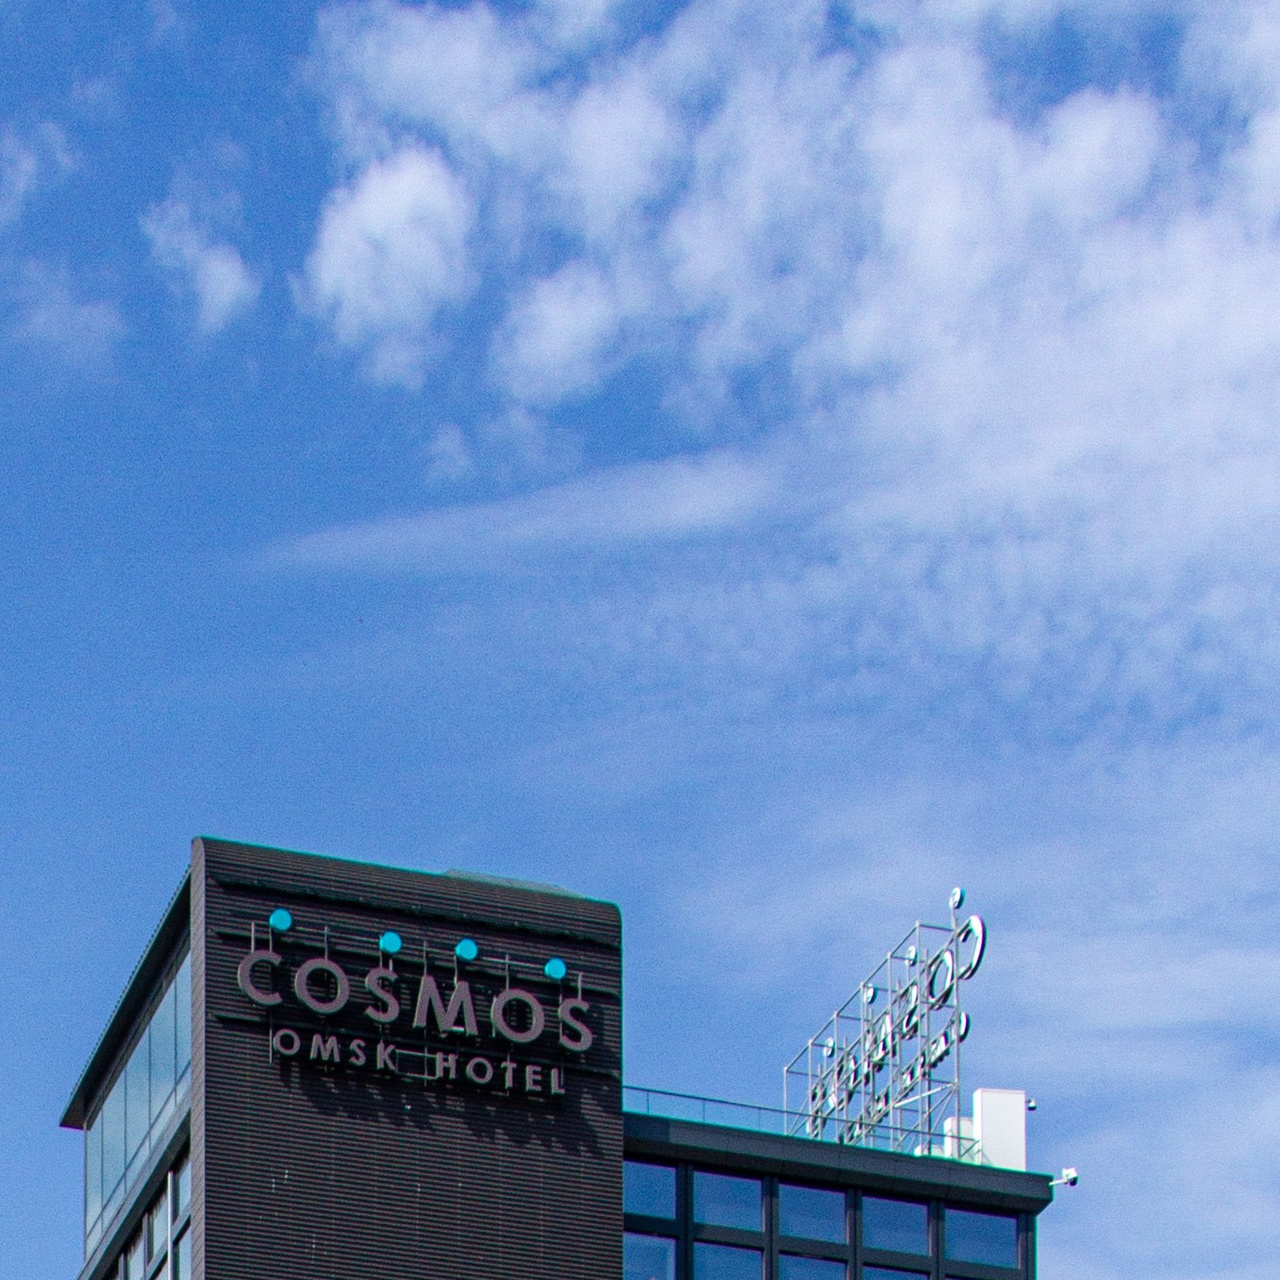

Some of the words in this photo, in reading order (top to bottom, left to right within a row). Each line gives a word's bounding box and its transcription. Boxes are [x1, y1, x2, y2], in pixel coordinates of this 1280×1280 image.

[237, 948, 593, 1052] COSMOS
[273, 1028, 397, 1072] OMSK
[435, 1051, 565, 1095] HOTEL
